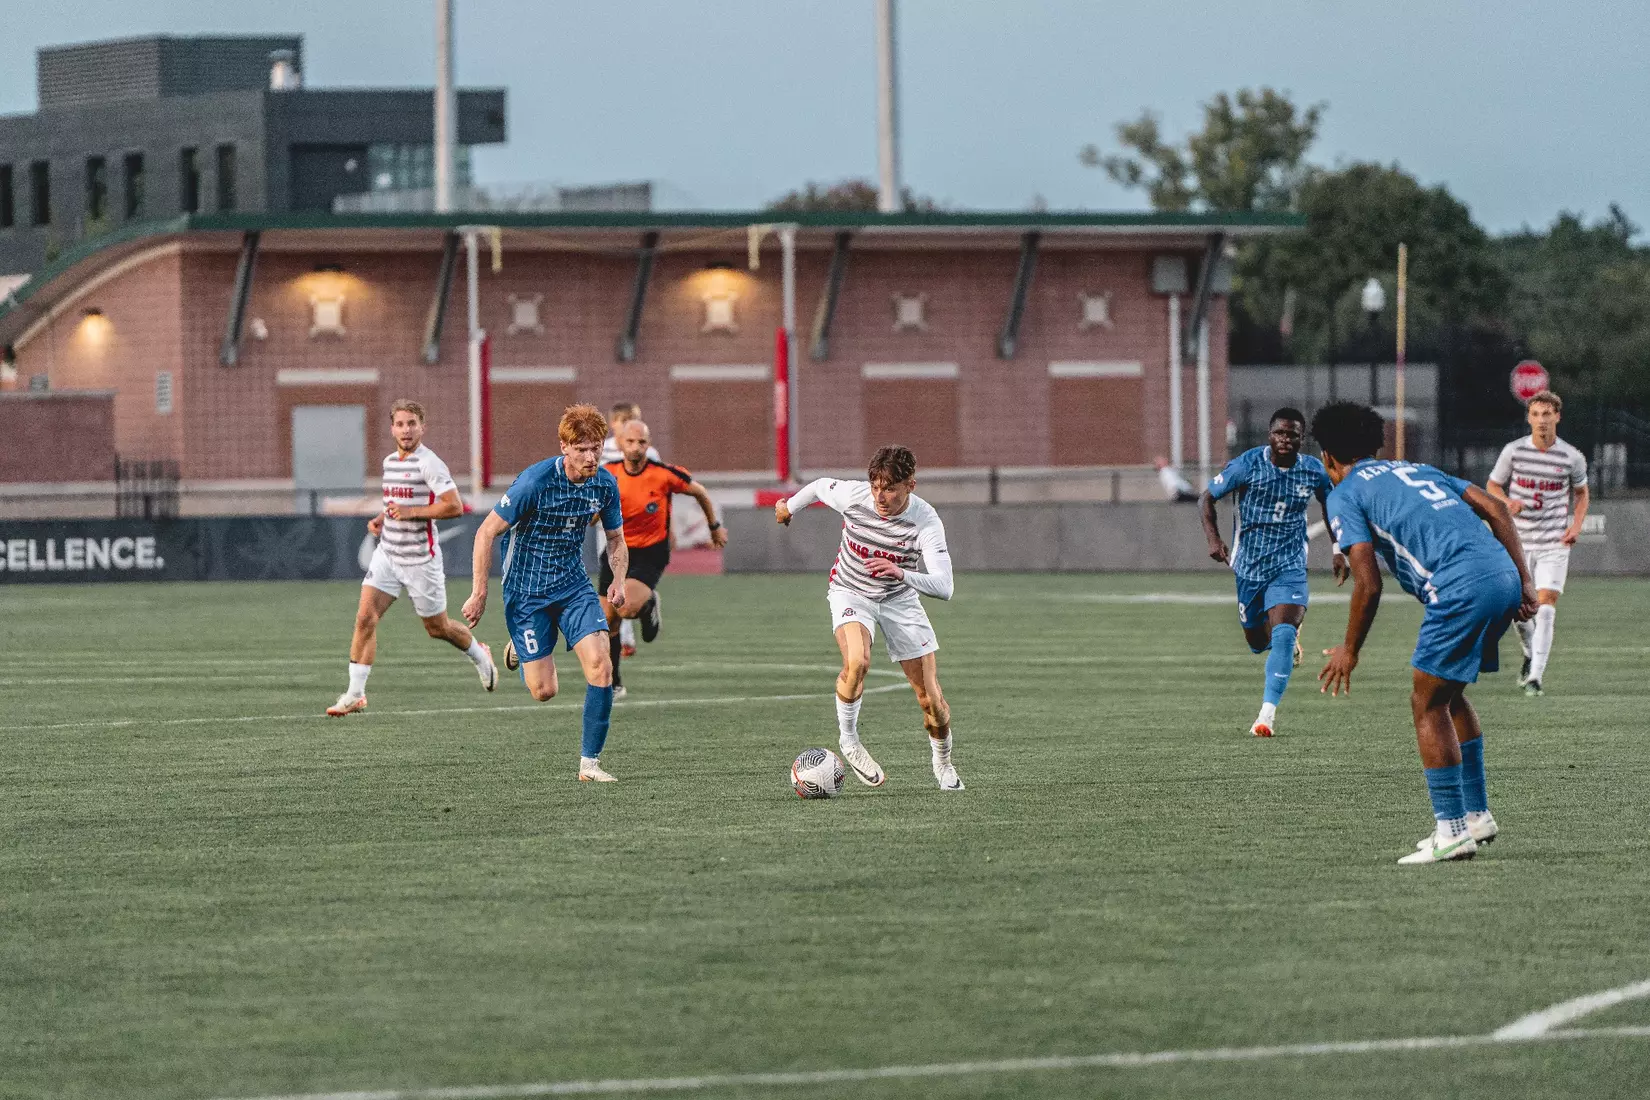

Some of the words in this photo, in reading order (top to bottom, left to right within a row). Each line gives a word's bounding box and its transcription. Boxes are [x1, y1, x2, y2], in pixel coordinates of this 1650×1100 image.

[390, 487, 413, 498] STATE
[1392, 466, 1447, 501] 5
[1272, 501, 1287, 522] 9
[1533, 493, 1543, 510] 5
[0, 536, 165, 571] ELLENCE.
[523, 629, 539, 654] 6
